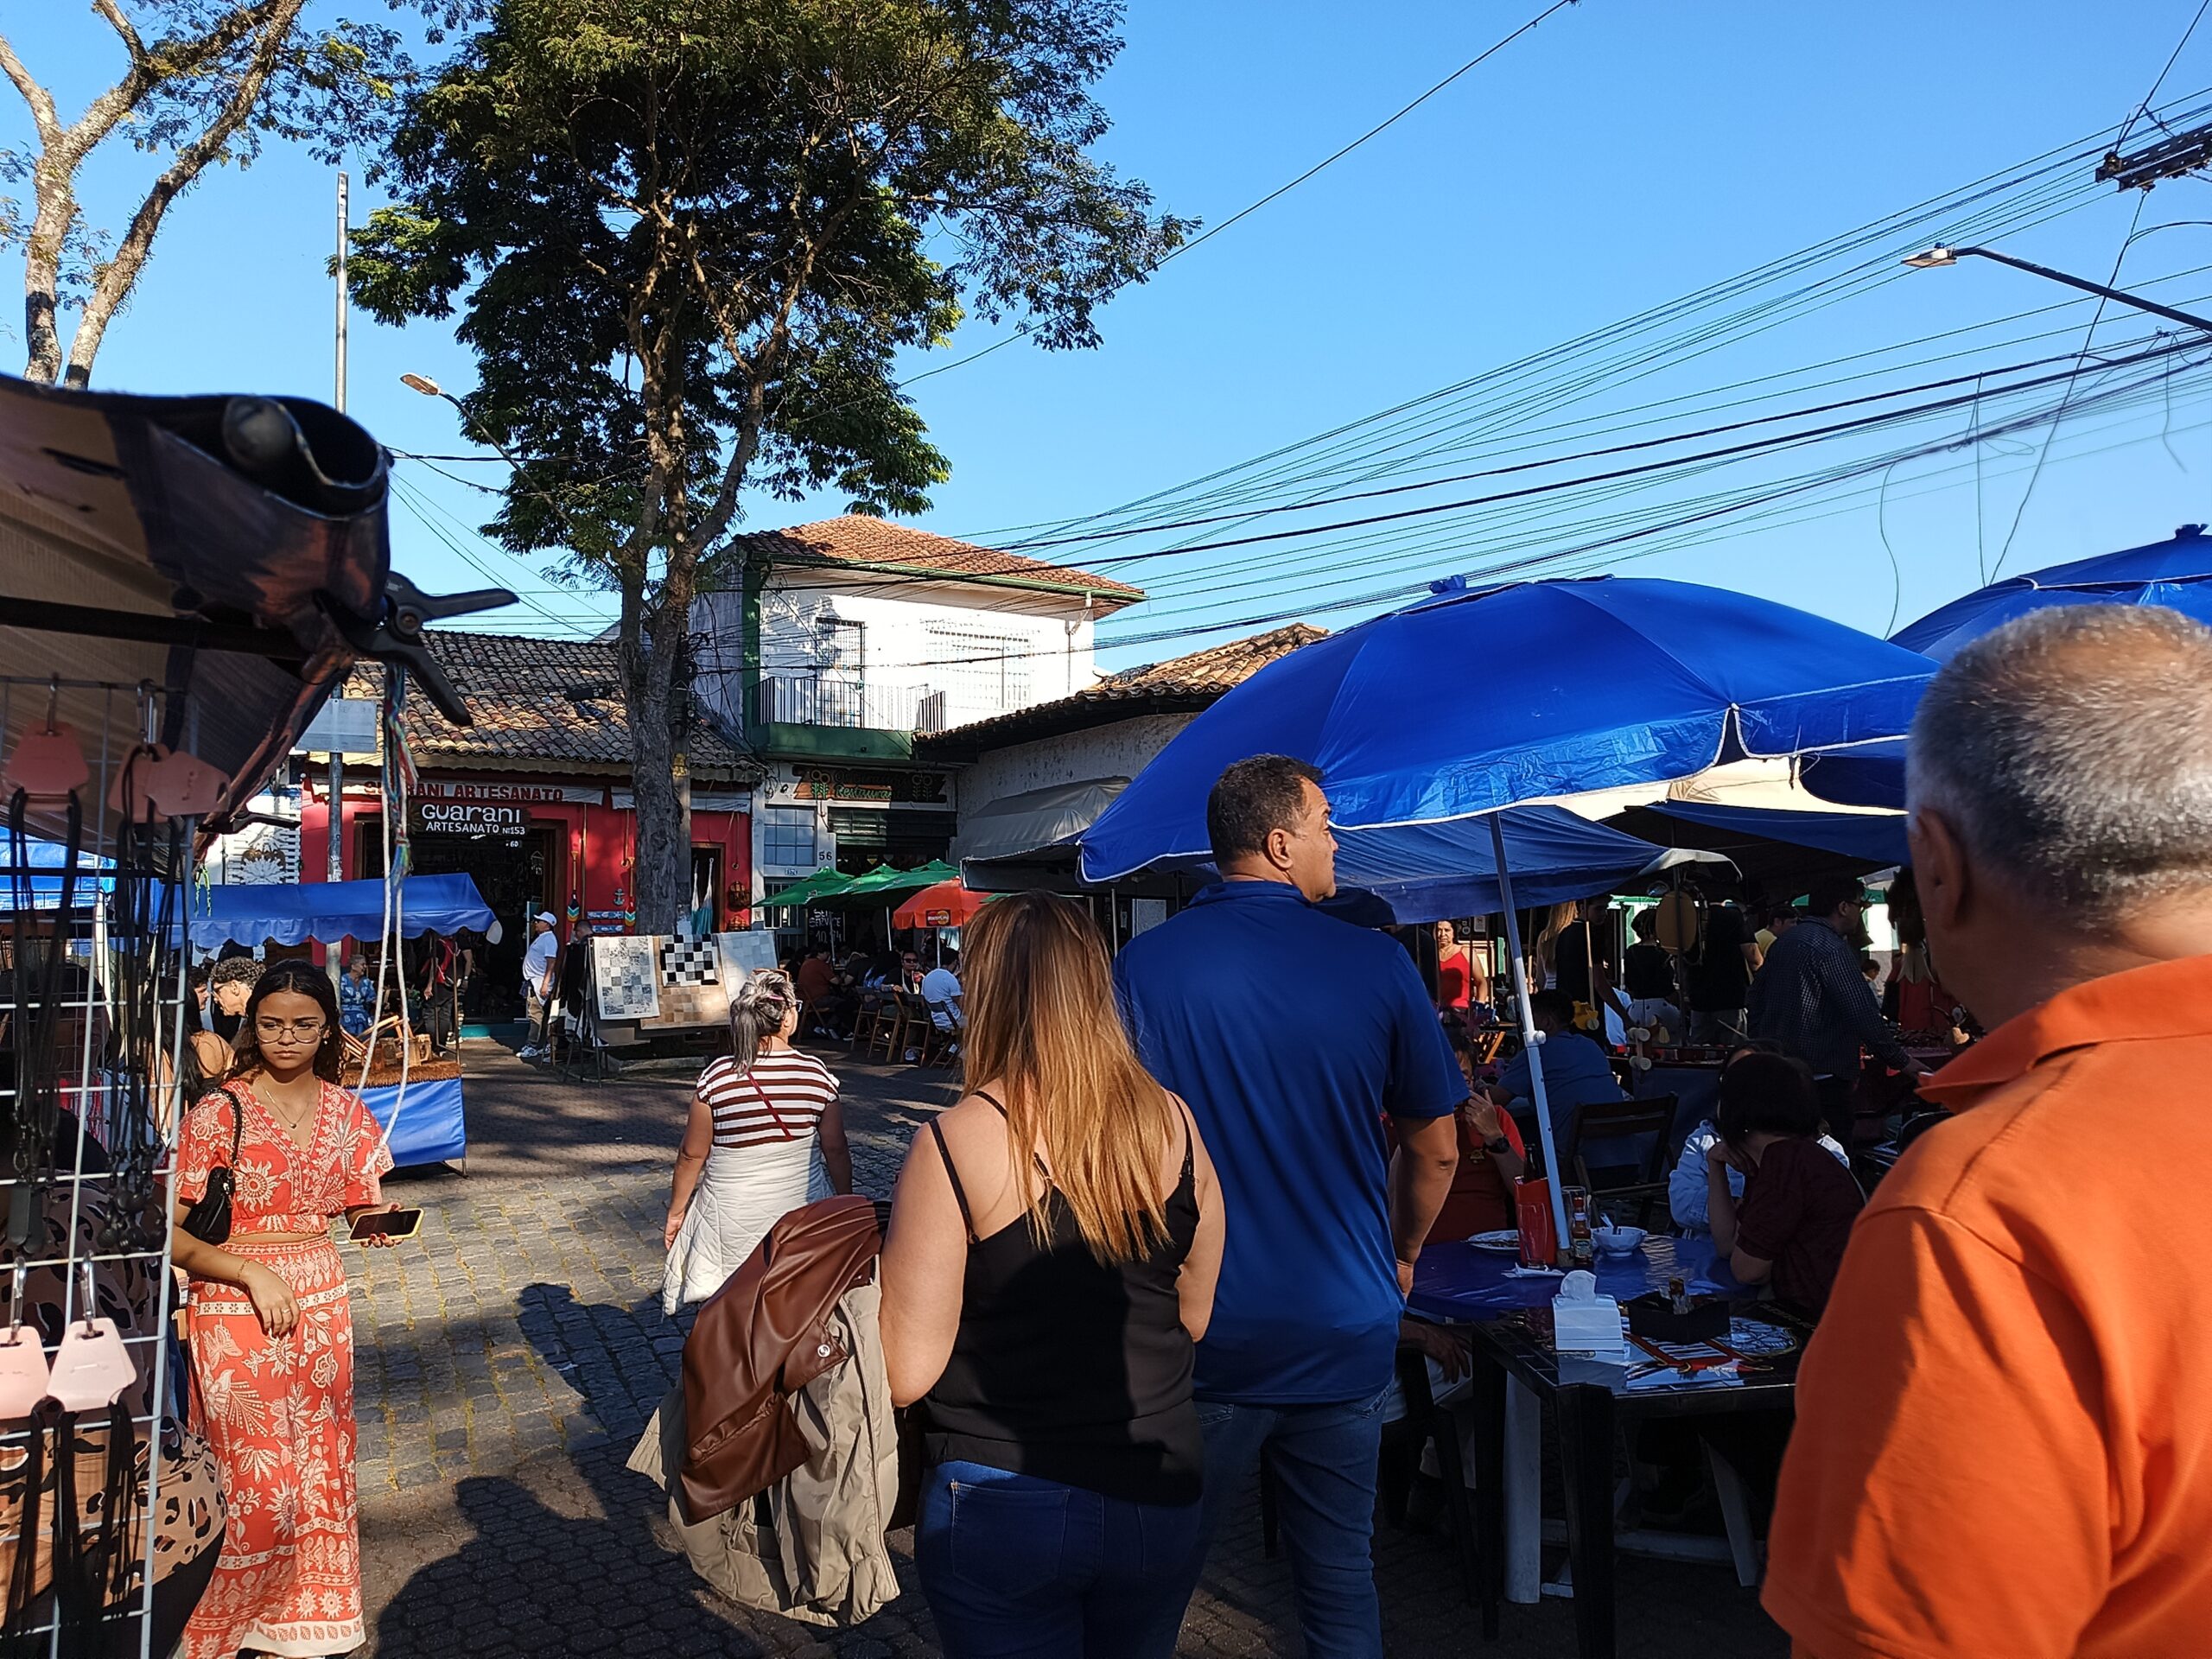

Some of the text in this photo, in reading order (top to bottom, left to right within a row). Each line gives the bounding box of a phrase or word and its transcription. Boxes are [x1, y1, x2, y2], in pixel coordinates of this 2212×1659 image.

[364, 780, 564, 802] GRANI ARTESANATO
[836, 785, 910, 799] Restaura
[425, 821, 499, 834] ARTESANATO
[818, 850, 832, 861] 56
[808, 917, 842, 928] SERVCE
